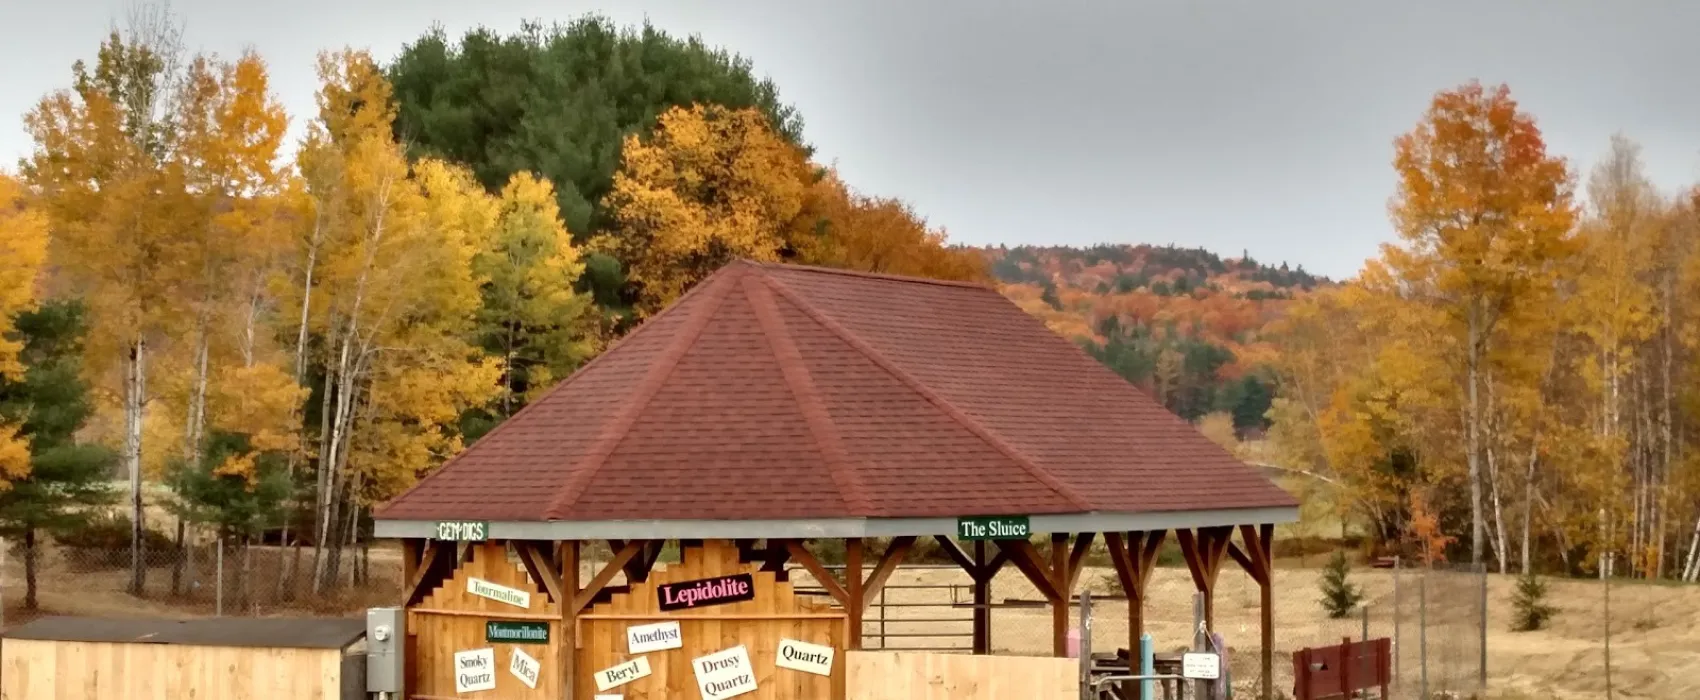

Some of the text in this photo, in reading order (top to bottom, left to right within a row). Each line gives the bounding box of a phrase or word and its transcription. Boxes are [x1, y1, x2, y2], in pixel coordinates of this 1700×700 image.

[462, 522, 484, 540] DIGS
[961, 520, 1026, 537] The Sluice
[473, 580, 524, 605] Tourmaline
[664, 578, 749, 606] Lepidolite
[488, 625, 547, 640] Montmorillonite
[631, 628, 678, 644] Amethyst
[460, 655, 488, 669] Smoky
[701, 654, 740, 674] Drusy
[782, 645, 828, 665] Quartz
[513, 654, 536, 682] Mica
[606, 661, 640, 683] Beryl
[460, 673, 490, 688] Quartz
[705, 674, 751, 696] Quartz
